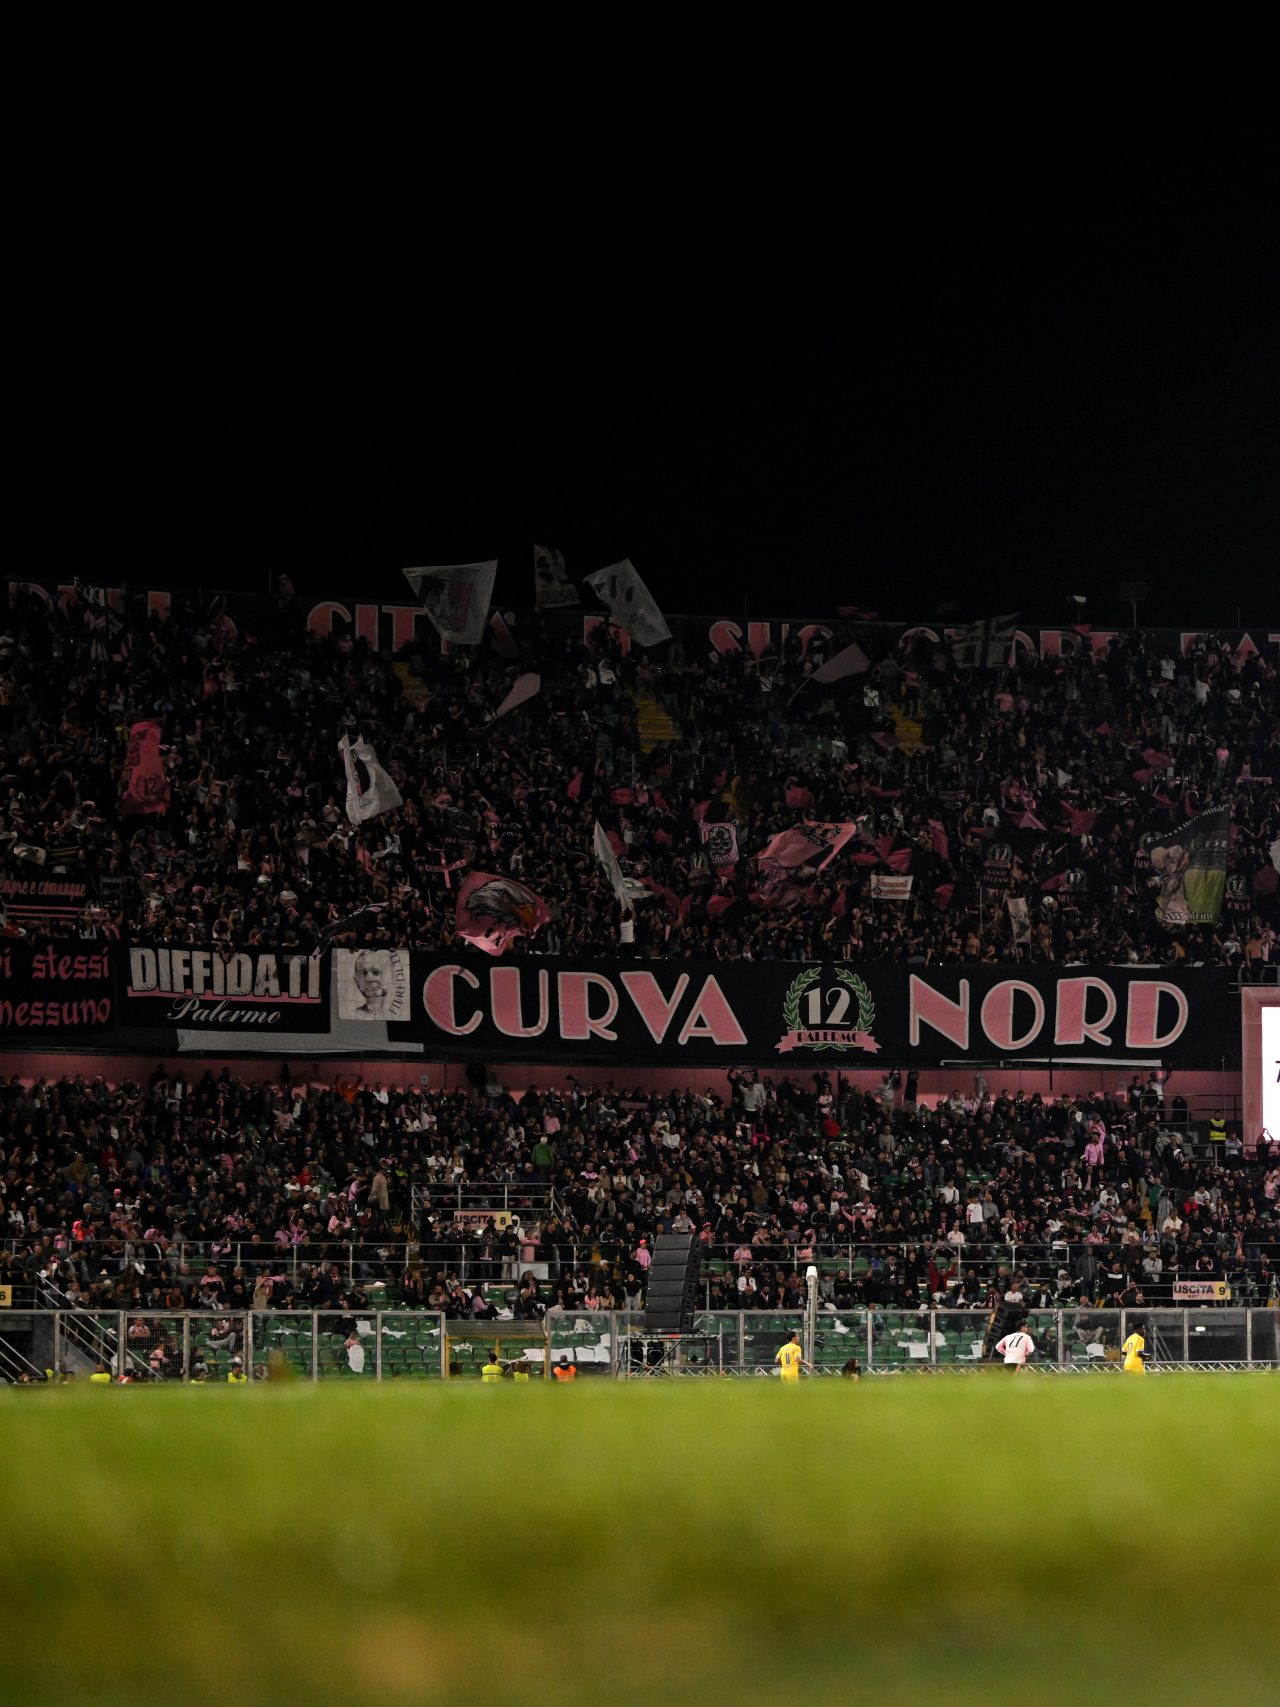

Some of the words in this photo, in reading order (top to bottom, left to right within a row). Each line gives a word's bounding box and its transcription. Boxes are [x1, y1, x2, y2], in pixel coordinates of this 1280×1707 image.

[32, 943, 111, 981] stessi
[129, 948, 321, 999] DIFFIDATI
[0, 996, 112, 1028] nessuno
[166, 994, 282, 1025] Palermo
[423, 964, 748, 1046] CURVA
[908, 973, 1189, 1051] NORD
[803, 987, 851, 1025] 12
[797, 1031, 861, 1045] PALERMO
[500, 1217, 506, 1225] 8
[1174, 1285, 1214, 1294] USCITA
[1219, 1287, 1225, 1295] 9
